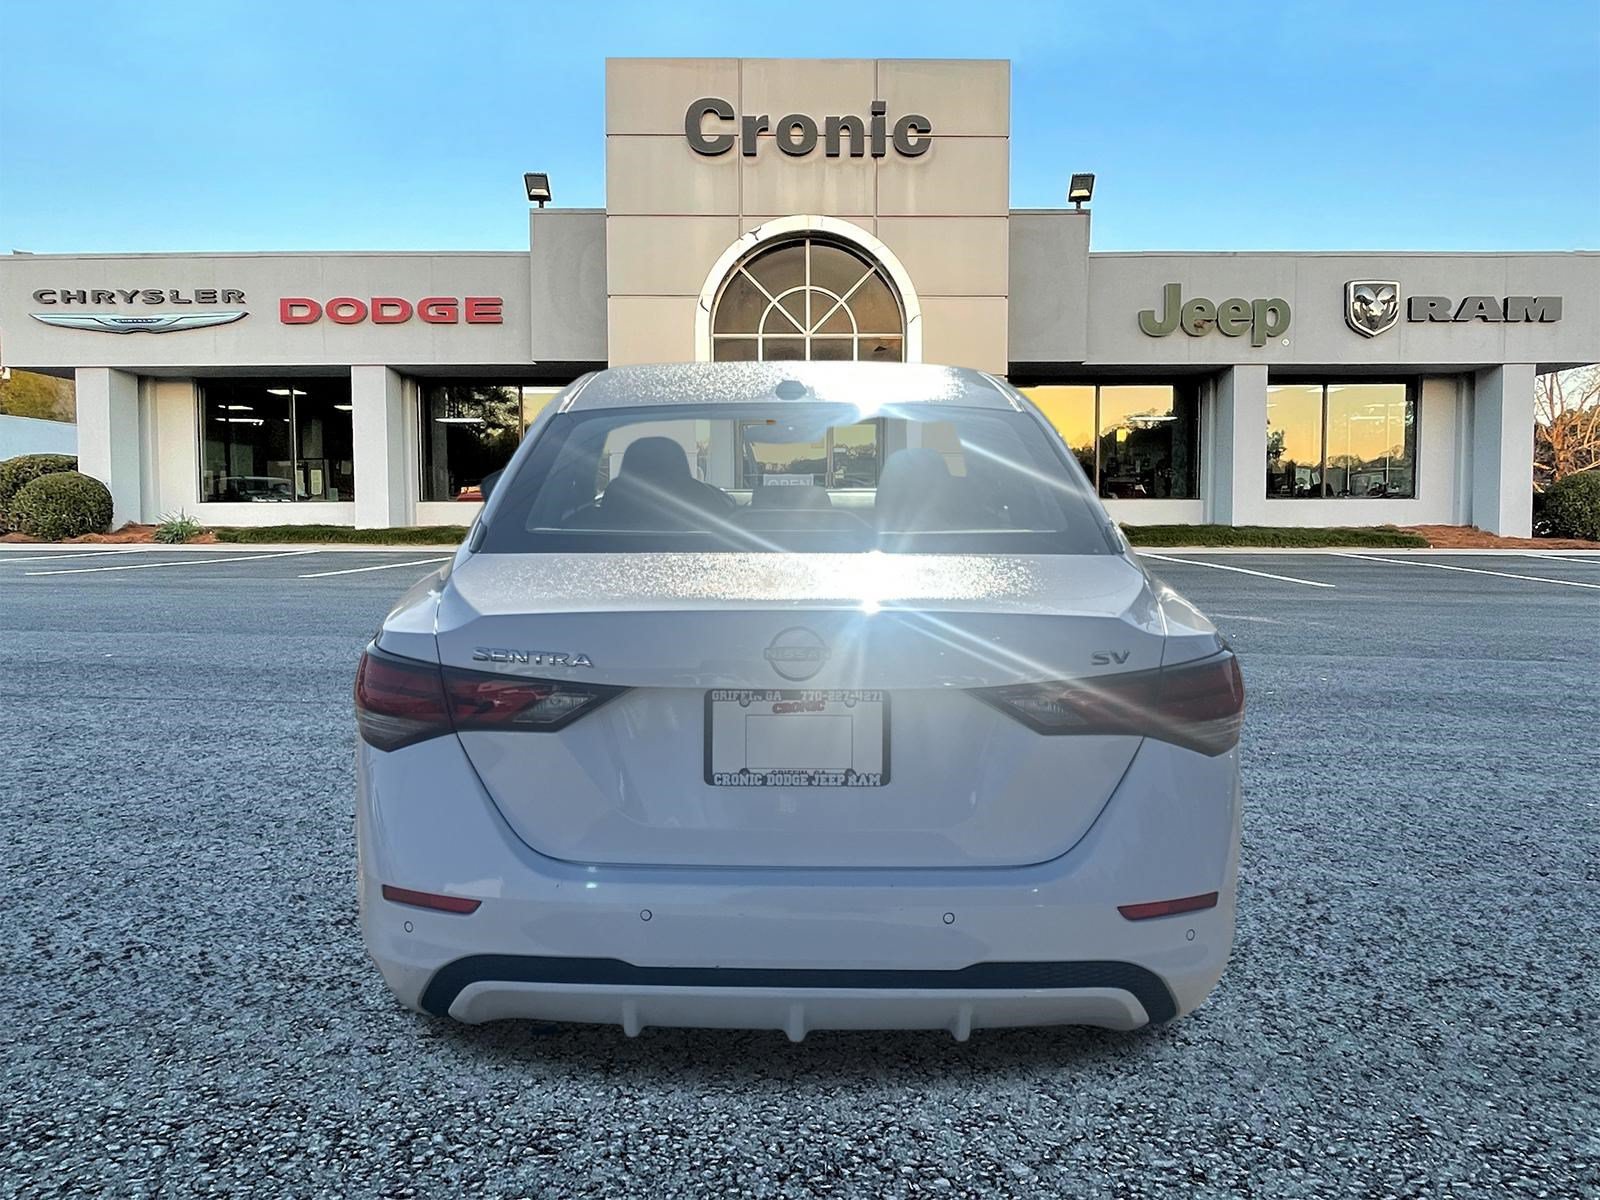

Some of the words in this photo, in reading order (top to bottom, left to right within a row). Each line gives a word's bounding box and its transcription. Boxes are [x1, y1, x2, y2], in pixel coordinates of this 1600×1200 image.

[684, 97, 932, 158] Cronic
[32, 289, 247, 304] CHRYSLER
[279, 297, 503, 325] DODGE
[1137, 283, 1292, 348] Jeep
[1407, 296, 1563, 323] RAM
[472, 647, 594, 669] SENTRA
[1090, 650, 1130, 666] SV
[765, 690, 782, 701] GA
[713, 773, 763, 786] CRONIC
[766, 773, 809, 786] DODGE
[811, 773, 845, 786] JEEP
[847, 773, 881, 786] RAM
